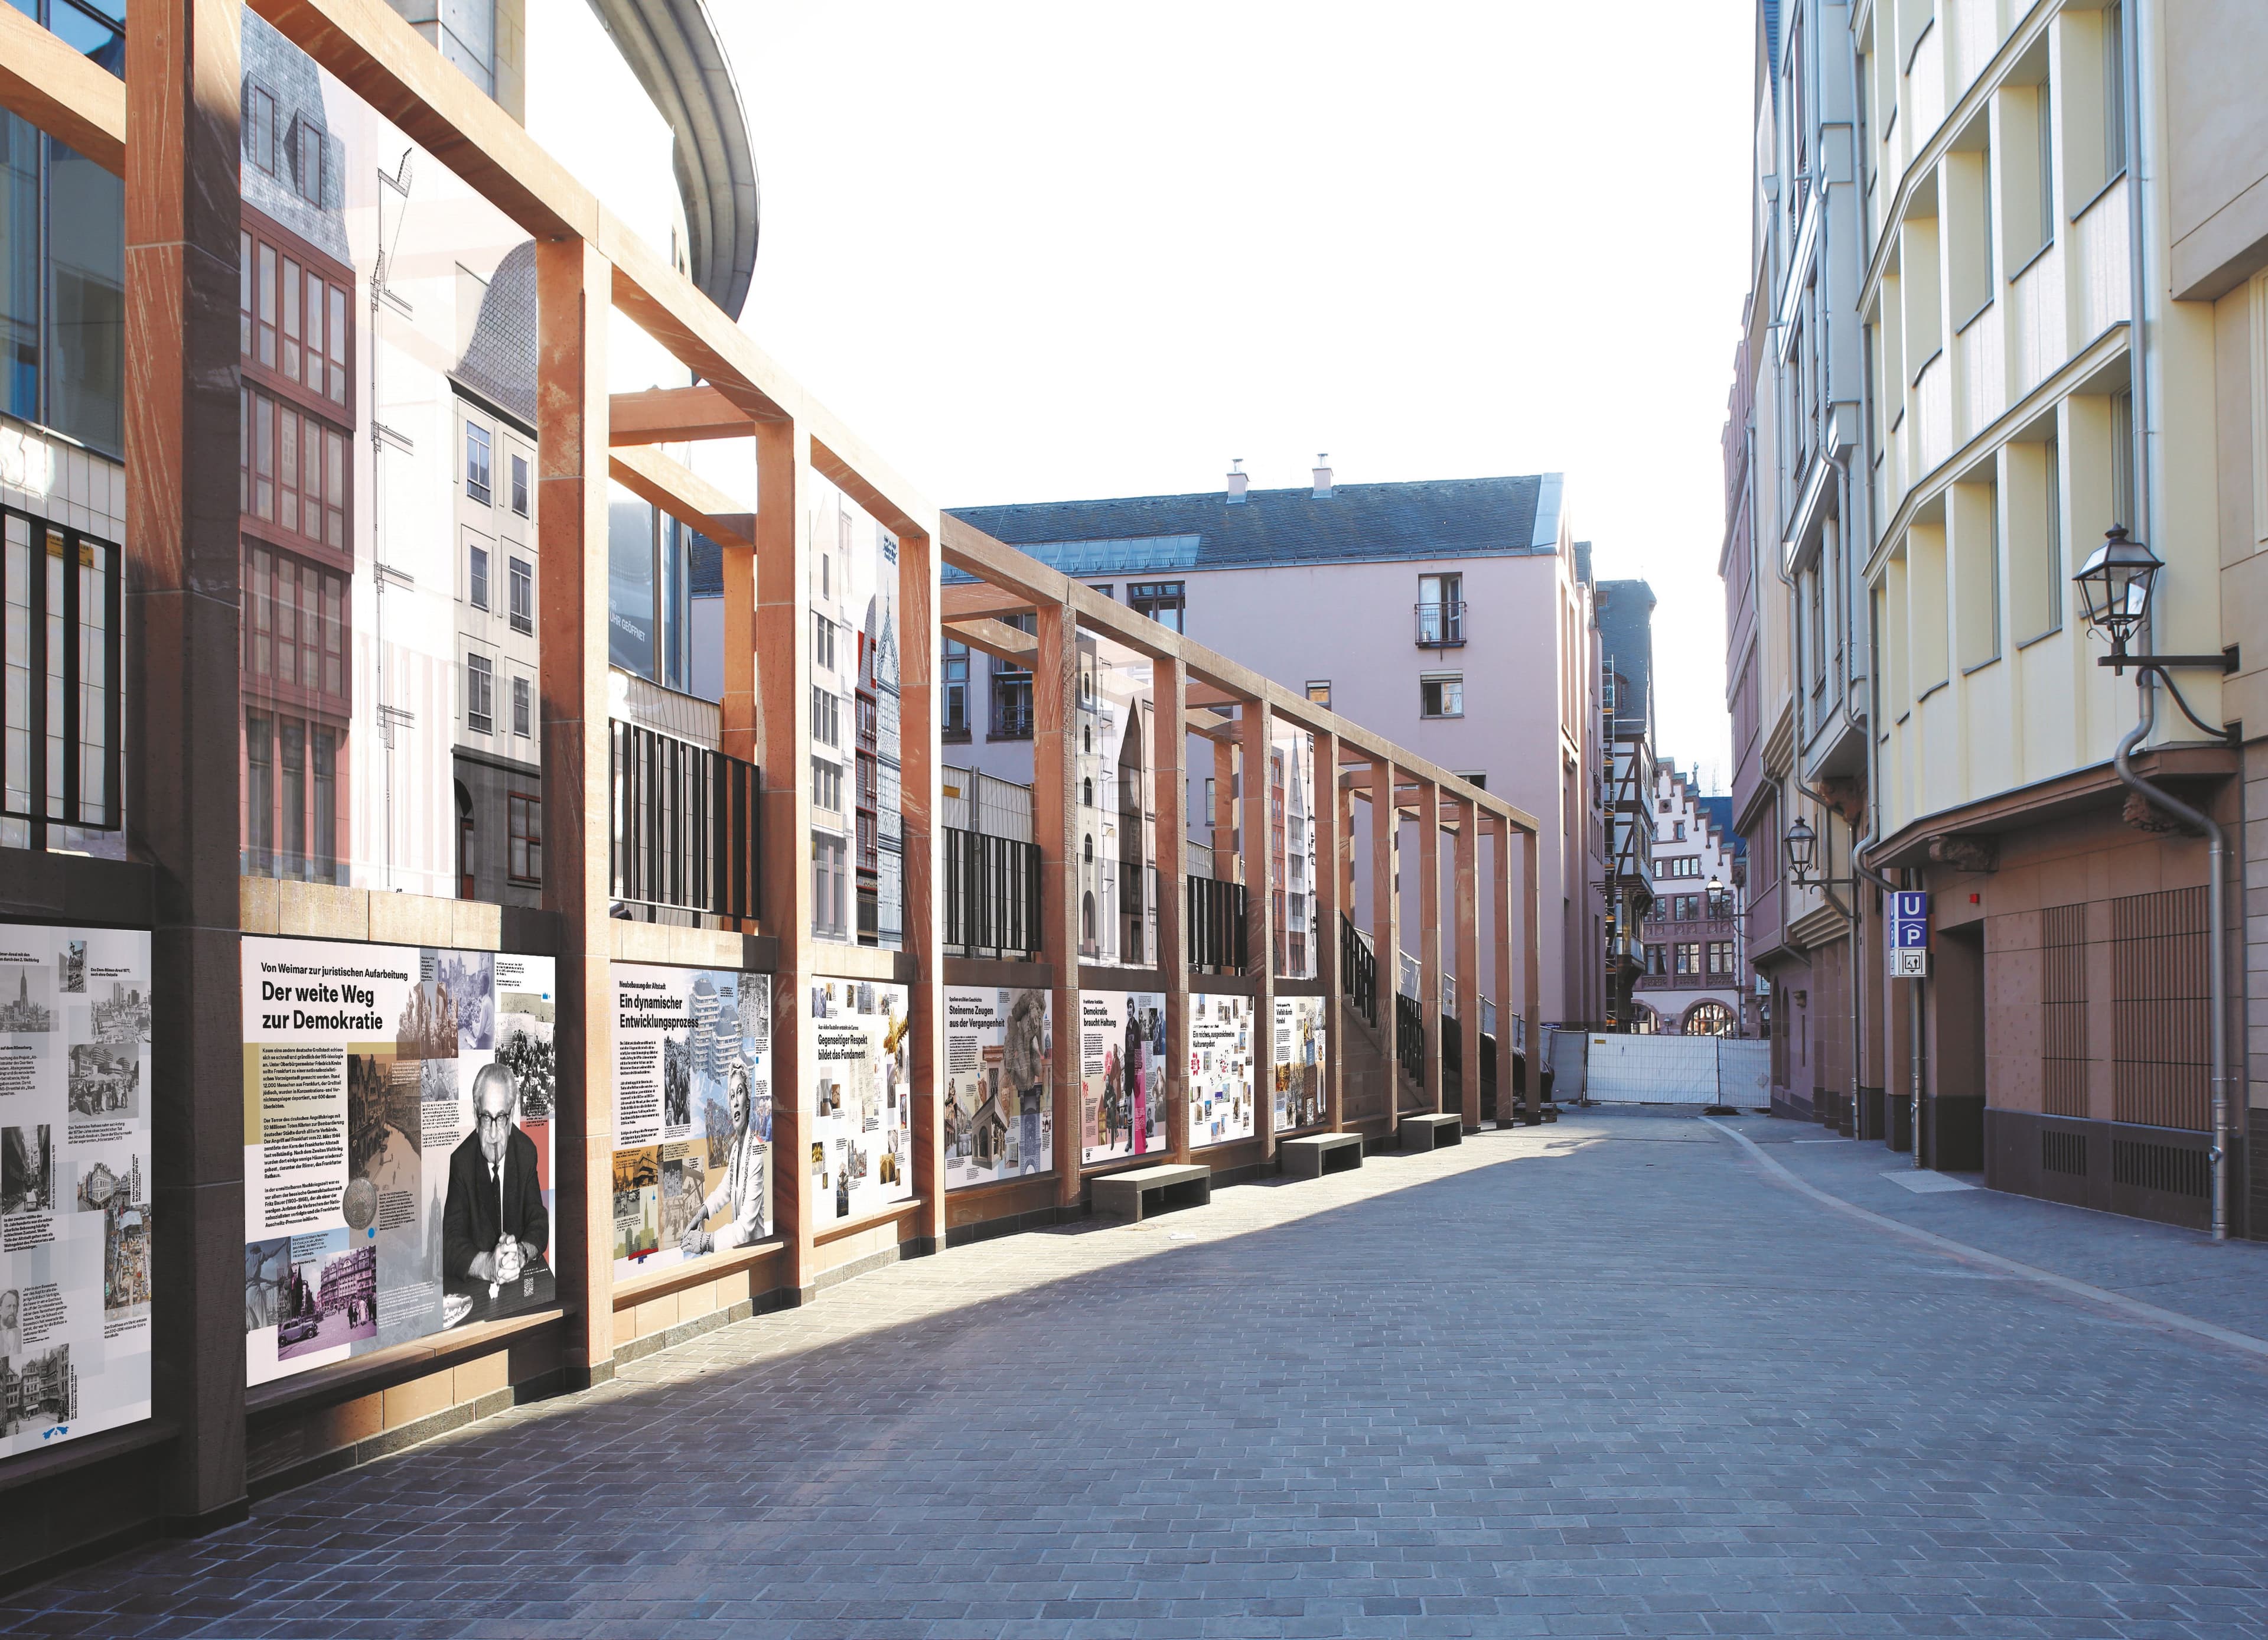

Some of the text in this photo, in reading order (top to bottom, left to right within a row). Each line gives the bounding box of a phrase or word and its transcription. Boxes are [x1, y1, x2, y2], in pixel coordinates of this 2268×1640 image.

[610, 611, 645, 642] UHR GEÖFFNET
[1905, 897, 1920, 915] U
[1908, 929, 1920, 945] P
[261, 962, 408, 981] Von Weimar zur juristischen Aufarbeitung
[620, 981, 645, 990] Neubebauung
[262, 981, 374, 1008] Der weite Weg
[620, 994, 682, 1011] Ein dynamischer
[949, 1006, 993, 1016] Steinerne Zeugen
[1084, 1007, 1107, 1015] Demokratie
[262, 1010, 383, 1029] zur Demokratie
[620, 1014, 699, 1030] Entwicklungsprozess
[960, 1018, 968, 1027] der
[969, 1018, 1005, 1029] Vergangenheit
[1084, 1018, 1116, 1027] braucht Haltung
[818, 1034, 867, 1047] Gegenseitiger Respekt
[1211, 1030, 1234, 1039] ausgezeichnetes
[819, 1049, 832, 1060] bildet
[841, 1049, 865, 1059] Fundament
